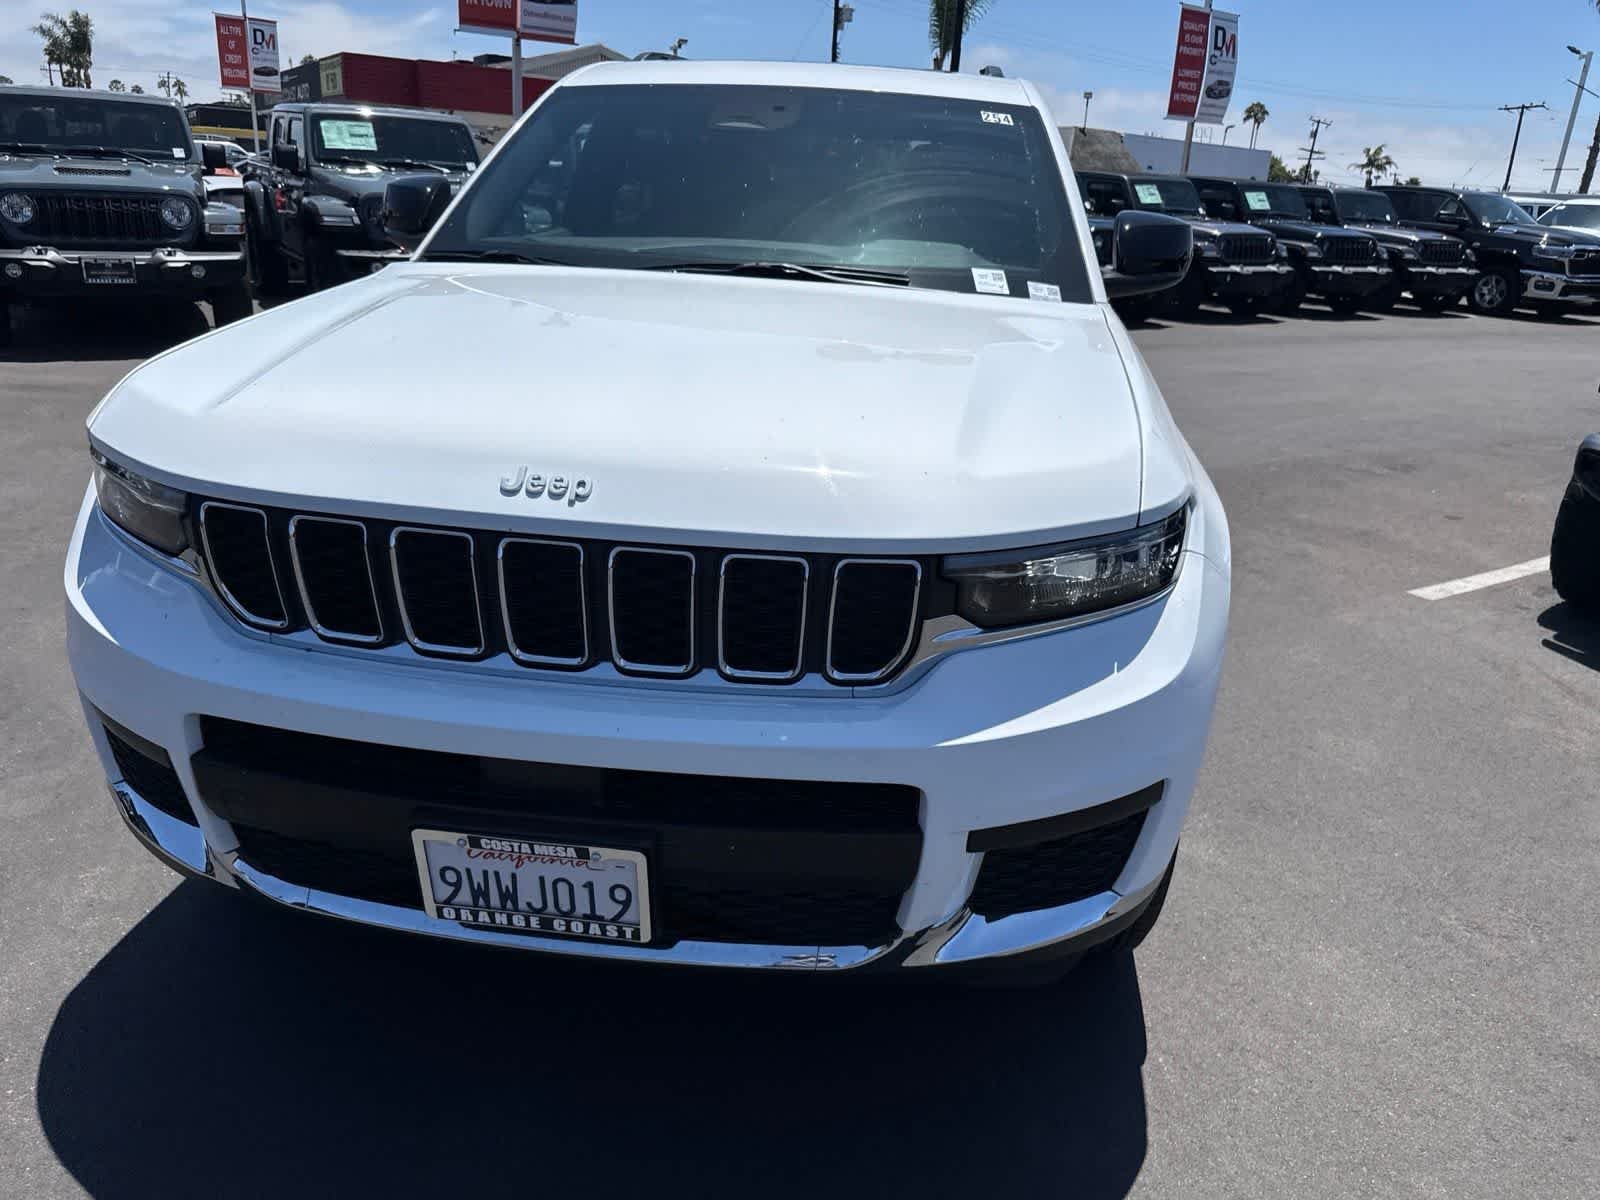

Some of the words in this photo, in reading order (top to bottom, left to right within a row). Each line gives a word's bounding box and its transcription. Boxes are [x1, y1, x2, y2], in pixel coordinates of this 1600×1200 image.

[220, 24, 230, 35] ALL
[1183, 21, 1207, 33] QUALITY
[228, 39, 237, 50] OF
[1178, 46, 1206, 57] PRIORITY
[224, 53, 242, 65] CREDIT
[1177, 68, 1201, 79] LOWEST
[1177, 81, 1198, 92] PRICES
[982, 111, 1012, 125] 254
[499, 464, 593, 507] Jeep
[480, 838, 533, 855] COSTA
[533, 841, 577, 858] MESA
[438, 865, 633, 922] 9WWJ019
[442, 907, 542, 929] ORANGE
[553, 918, 636, 940] COAST
